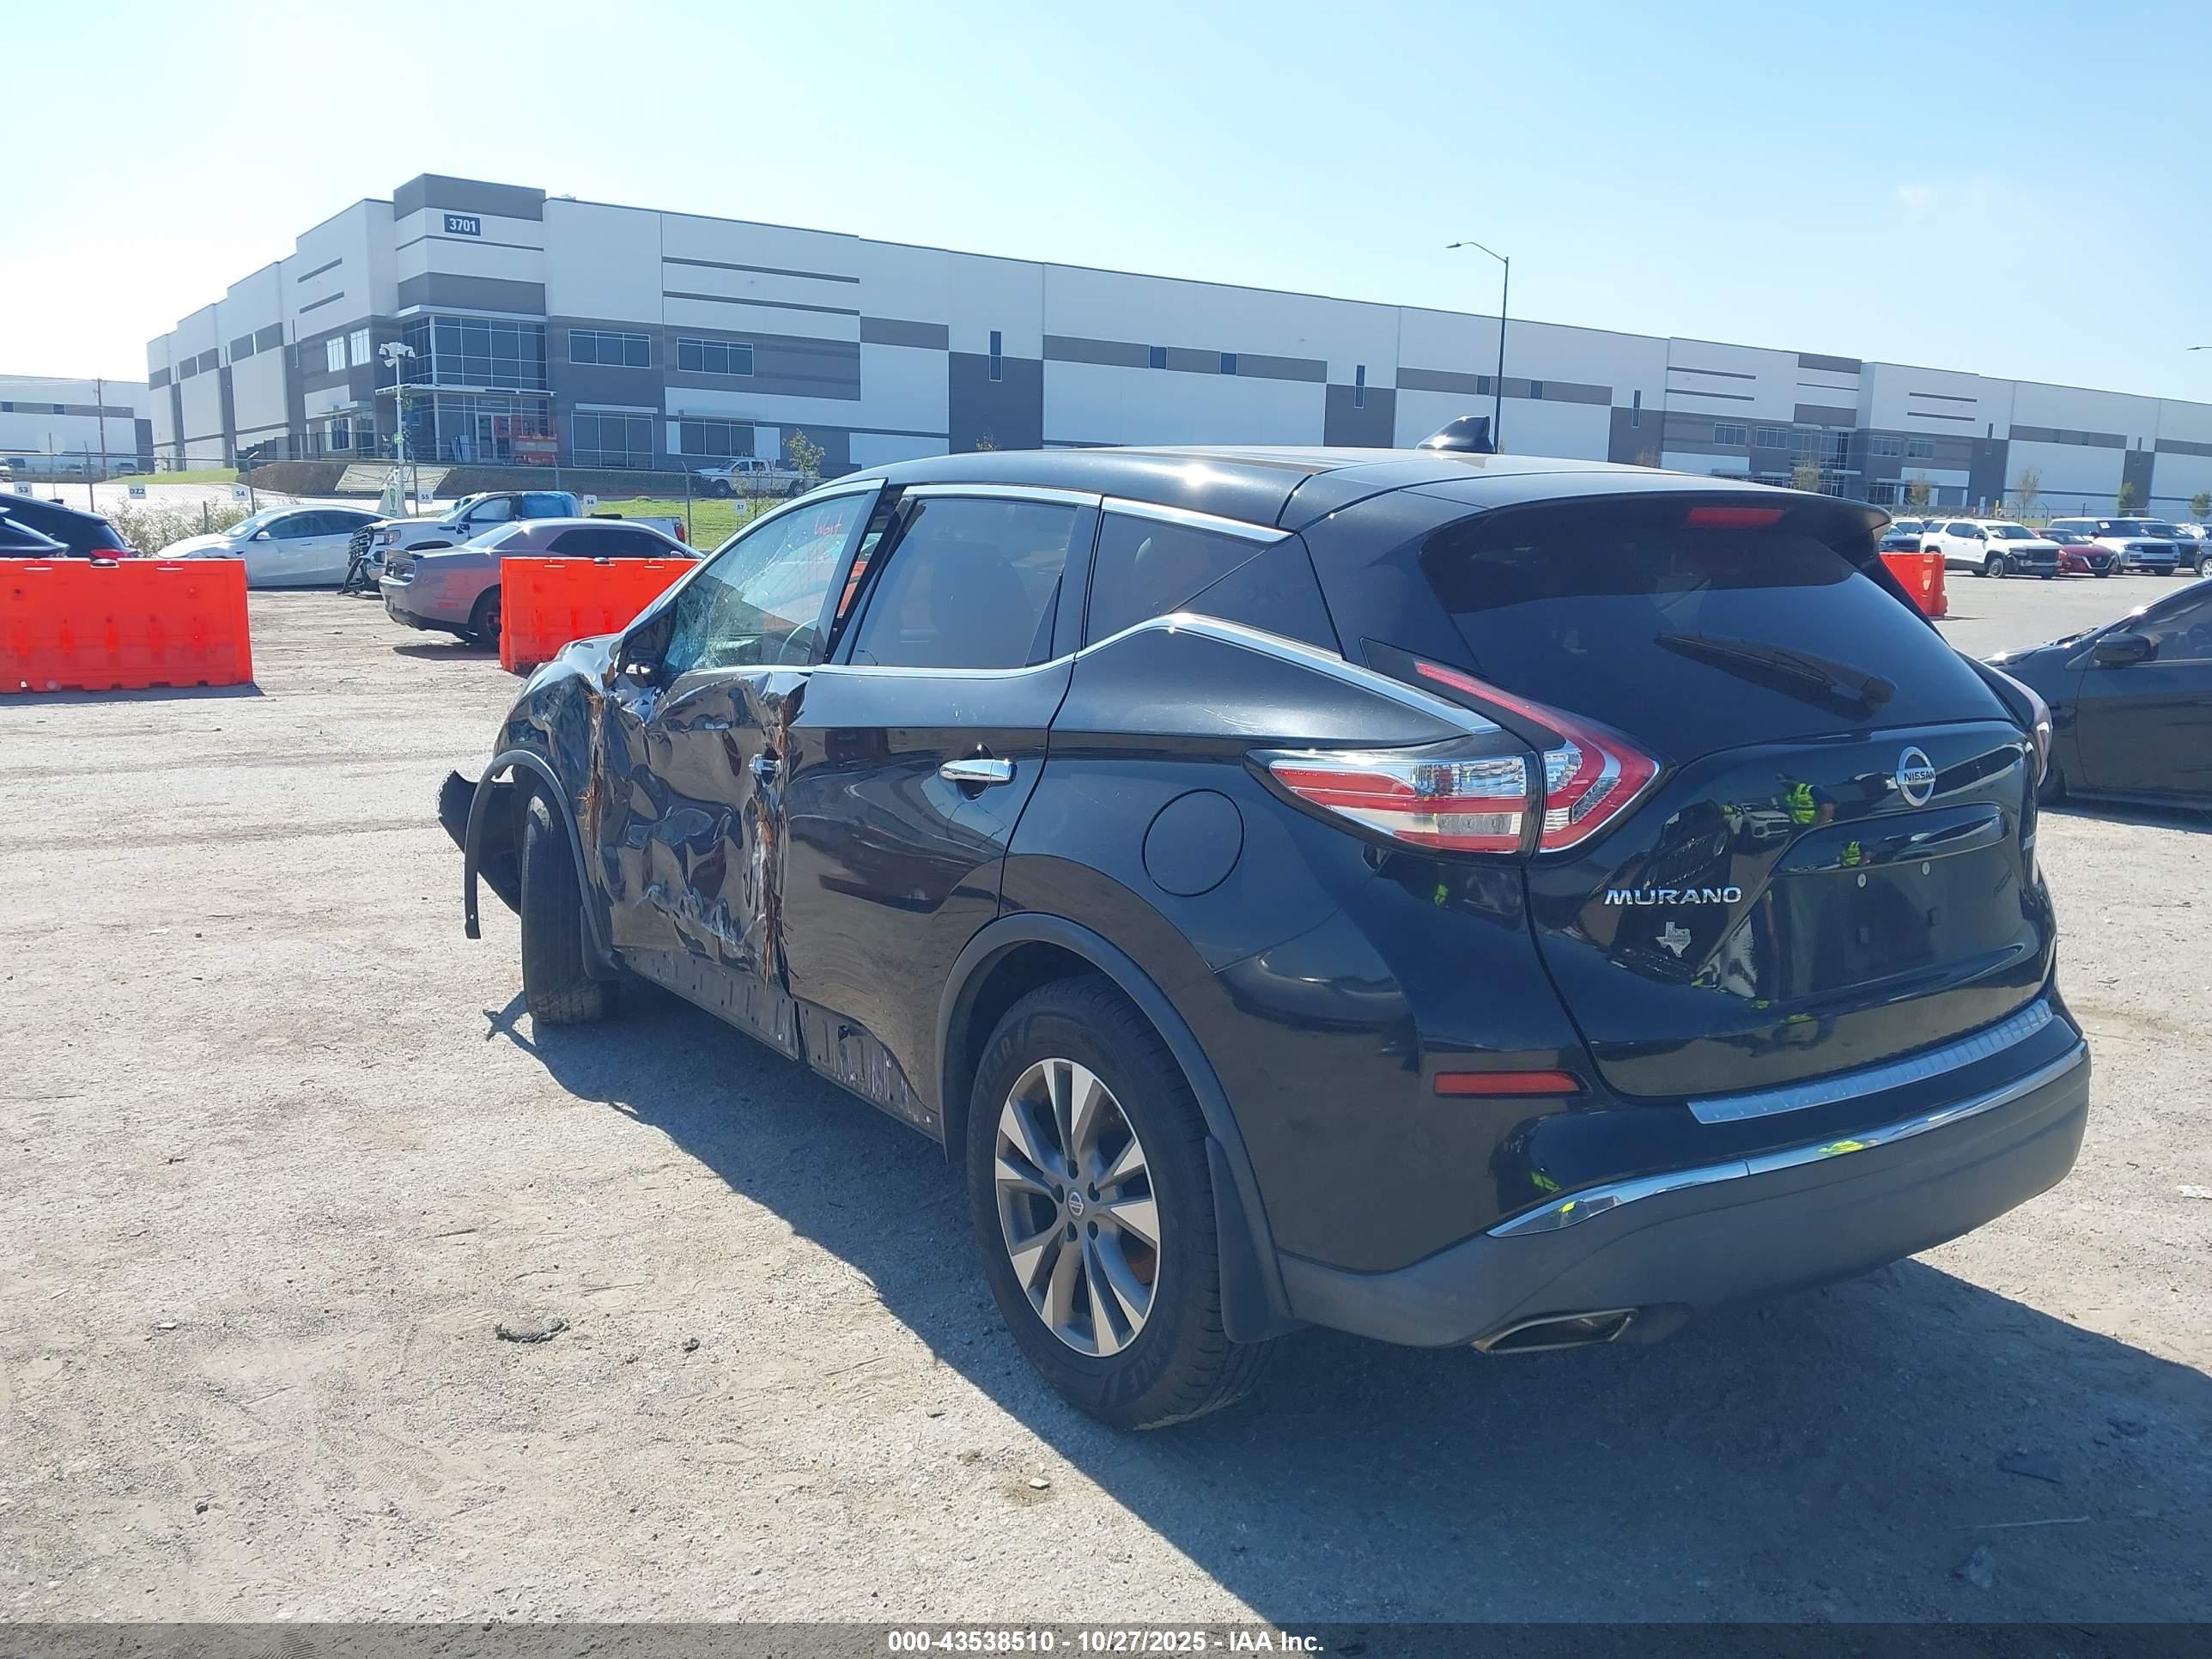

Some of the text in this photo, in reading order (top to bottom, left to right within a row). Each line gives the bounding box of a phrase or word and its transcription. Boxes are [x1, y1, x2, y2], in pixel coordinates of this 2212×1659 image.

[449, 218, 476, 233] 3701
[1904, 770, 1936, 781] NISSAN
[1604, 887, 1741, 905] MURANO
